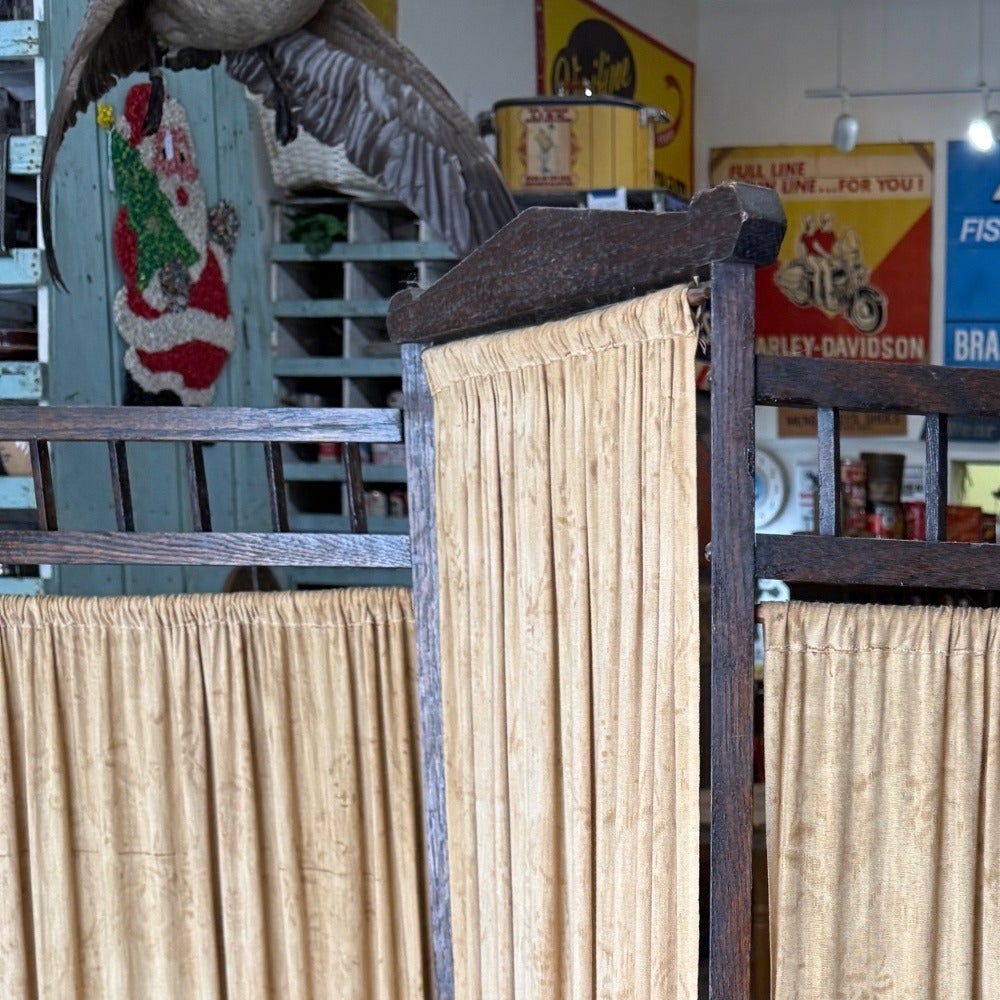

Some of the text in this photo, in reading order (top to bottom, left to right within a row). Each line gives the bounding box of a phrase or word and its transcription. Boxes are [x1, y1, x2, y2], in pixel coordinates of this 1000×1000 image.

[729, 162, 805, 179] FULL LINE
[755, 335, 925, 360] ARLEY-DAVIDSON
